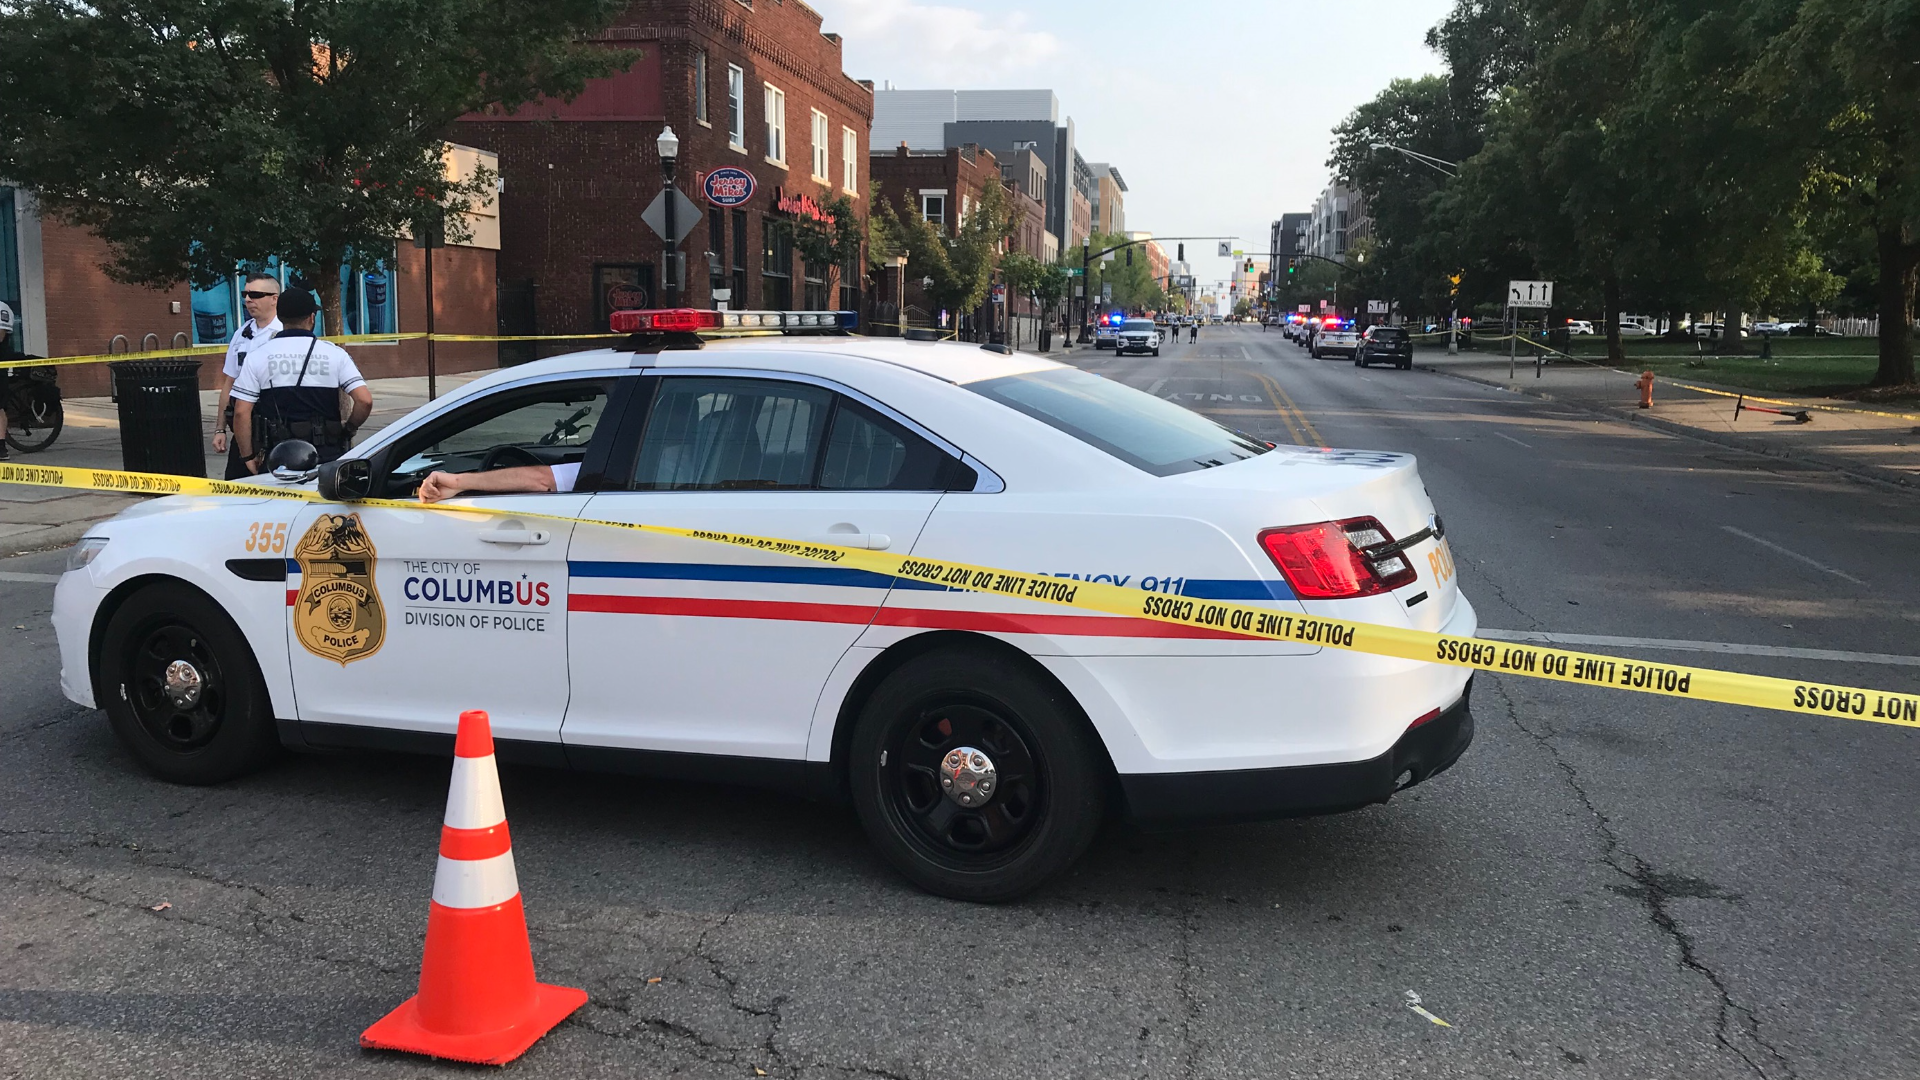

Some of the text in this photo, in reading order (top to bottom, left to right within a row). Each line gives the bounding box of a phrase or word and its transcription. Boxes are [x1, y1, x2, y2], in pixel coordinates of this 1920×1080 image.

[710, 174, 747, 188] Jersey
[267, 359, 330, 377] POLCE
[1, 466, 63, 485] POLICE LINE DO NOT
[92, 472, 181, 492] POLICE LINE DO NOT CROSS
[245, 521, 287, 554] 355
[798, 546, 845, 562] POLICE
[403, 560, 480, 575] THE CITY OF
[898, 560, 944, 580] CROSS
[942, 567, 972, 585] NOT
[972, 571, 994, 589] DO
[993, 574, 1026, 595] LINE
[1140, 576, 1184, 596] 911
[313, 582, 365, 599] COLUMBUS
[404, 576, 550, 607] COLUMBUS
[1026, 579, 1078, 604] POLICE
[405, 612, 545, 632] DIVISION OF POLICE
[1143, 595, 1355, 647] POLICE LINE DO NOT CROSS
[323, 634, 359, 648] POLICE
[1437, 638, 1692, 694] POLICE LINE DO NOT CROSS
[1793, 685, 1918, 722] NOT CROSS
